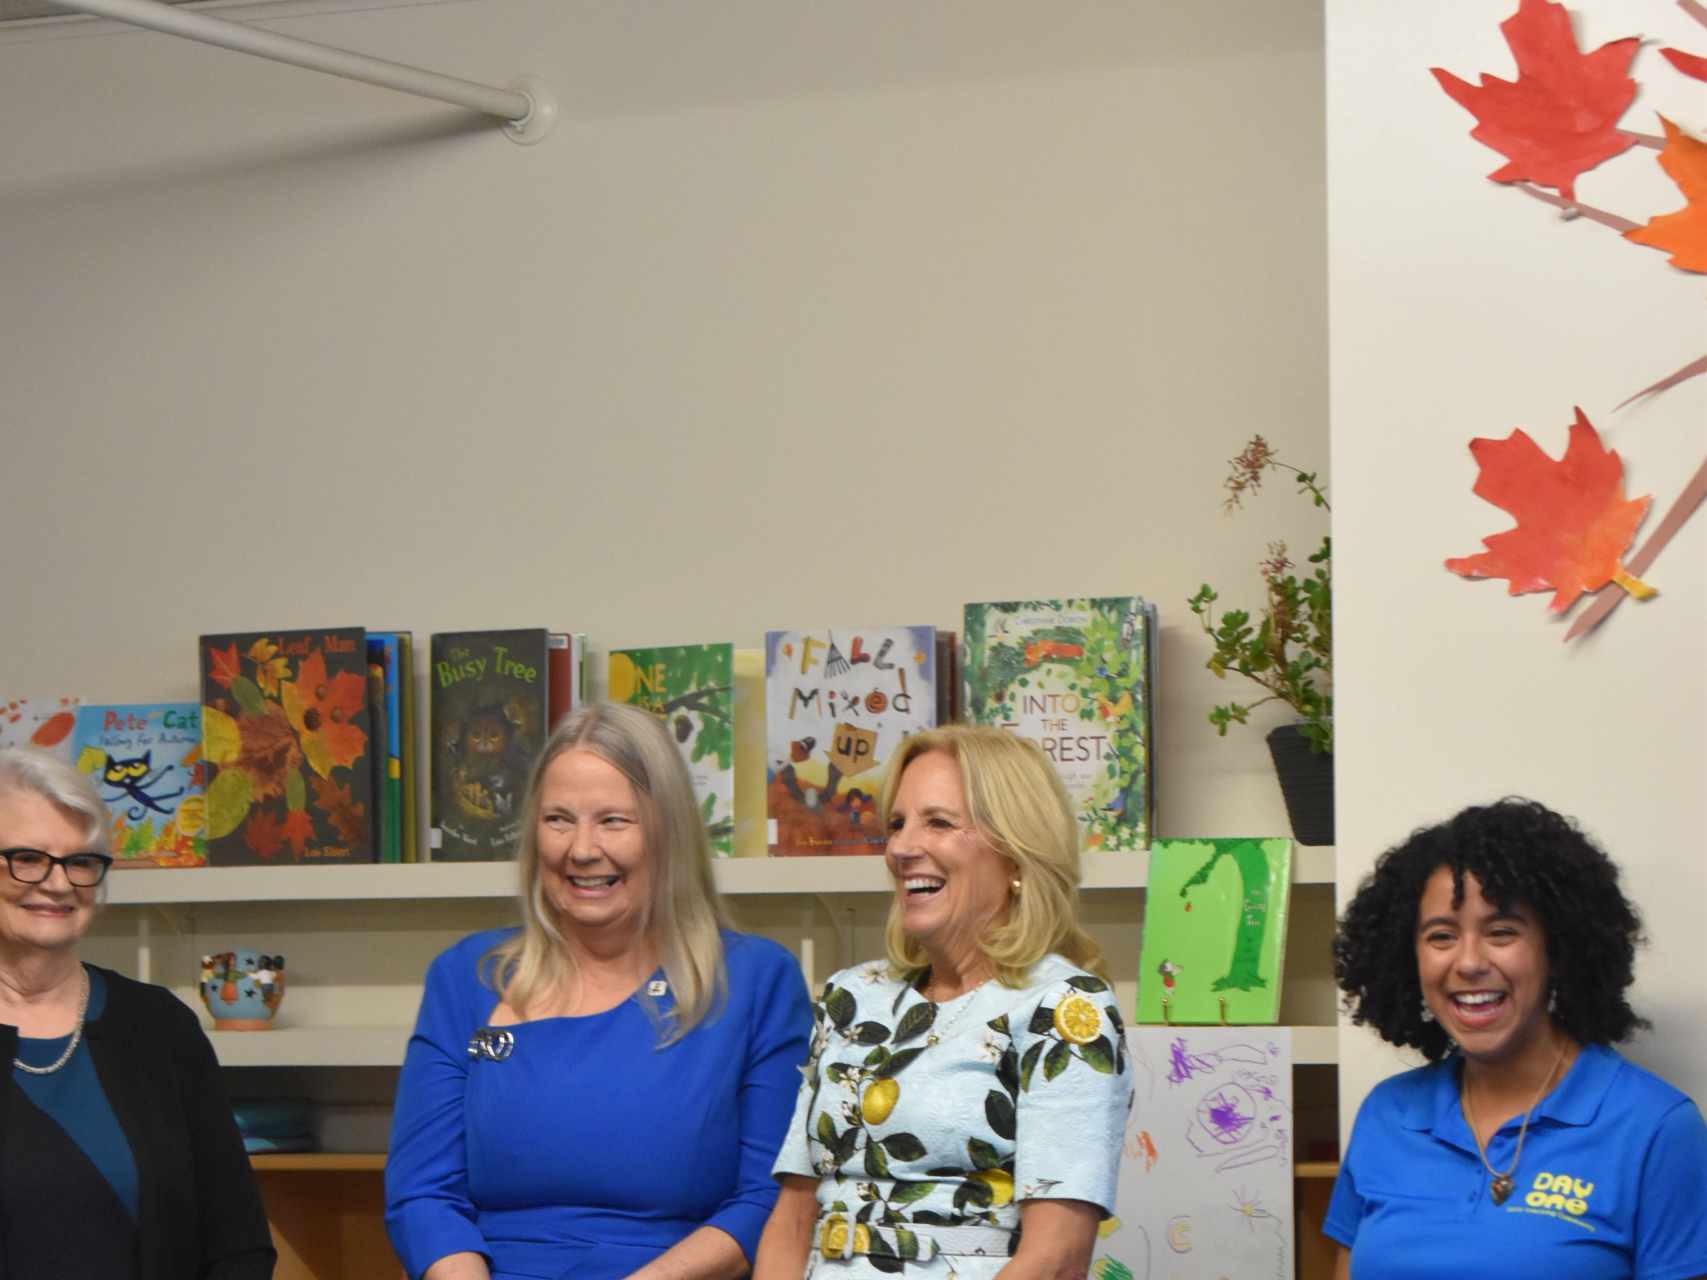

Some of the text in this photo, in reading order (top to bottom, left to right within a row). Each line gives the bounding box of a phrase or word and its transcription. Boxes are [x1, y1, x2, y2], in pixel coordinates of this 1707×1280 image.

[277, 634, 356, 655] Leaf Man
[798, 629, 896, 680] FALL
[436, 646, 537, 688] Busy Tree
[1022, 693, 1080, 714] INTO
[103, 710, 148, 732] Pete
[163, 710, 199, 729] Cat
[1040, 718, 1069, 732] THE
[837, 735, 870, 764] up
